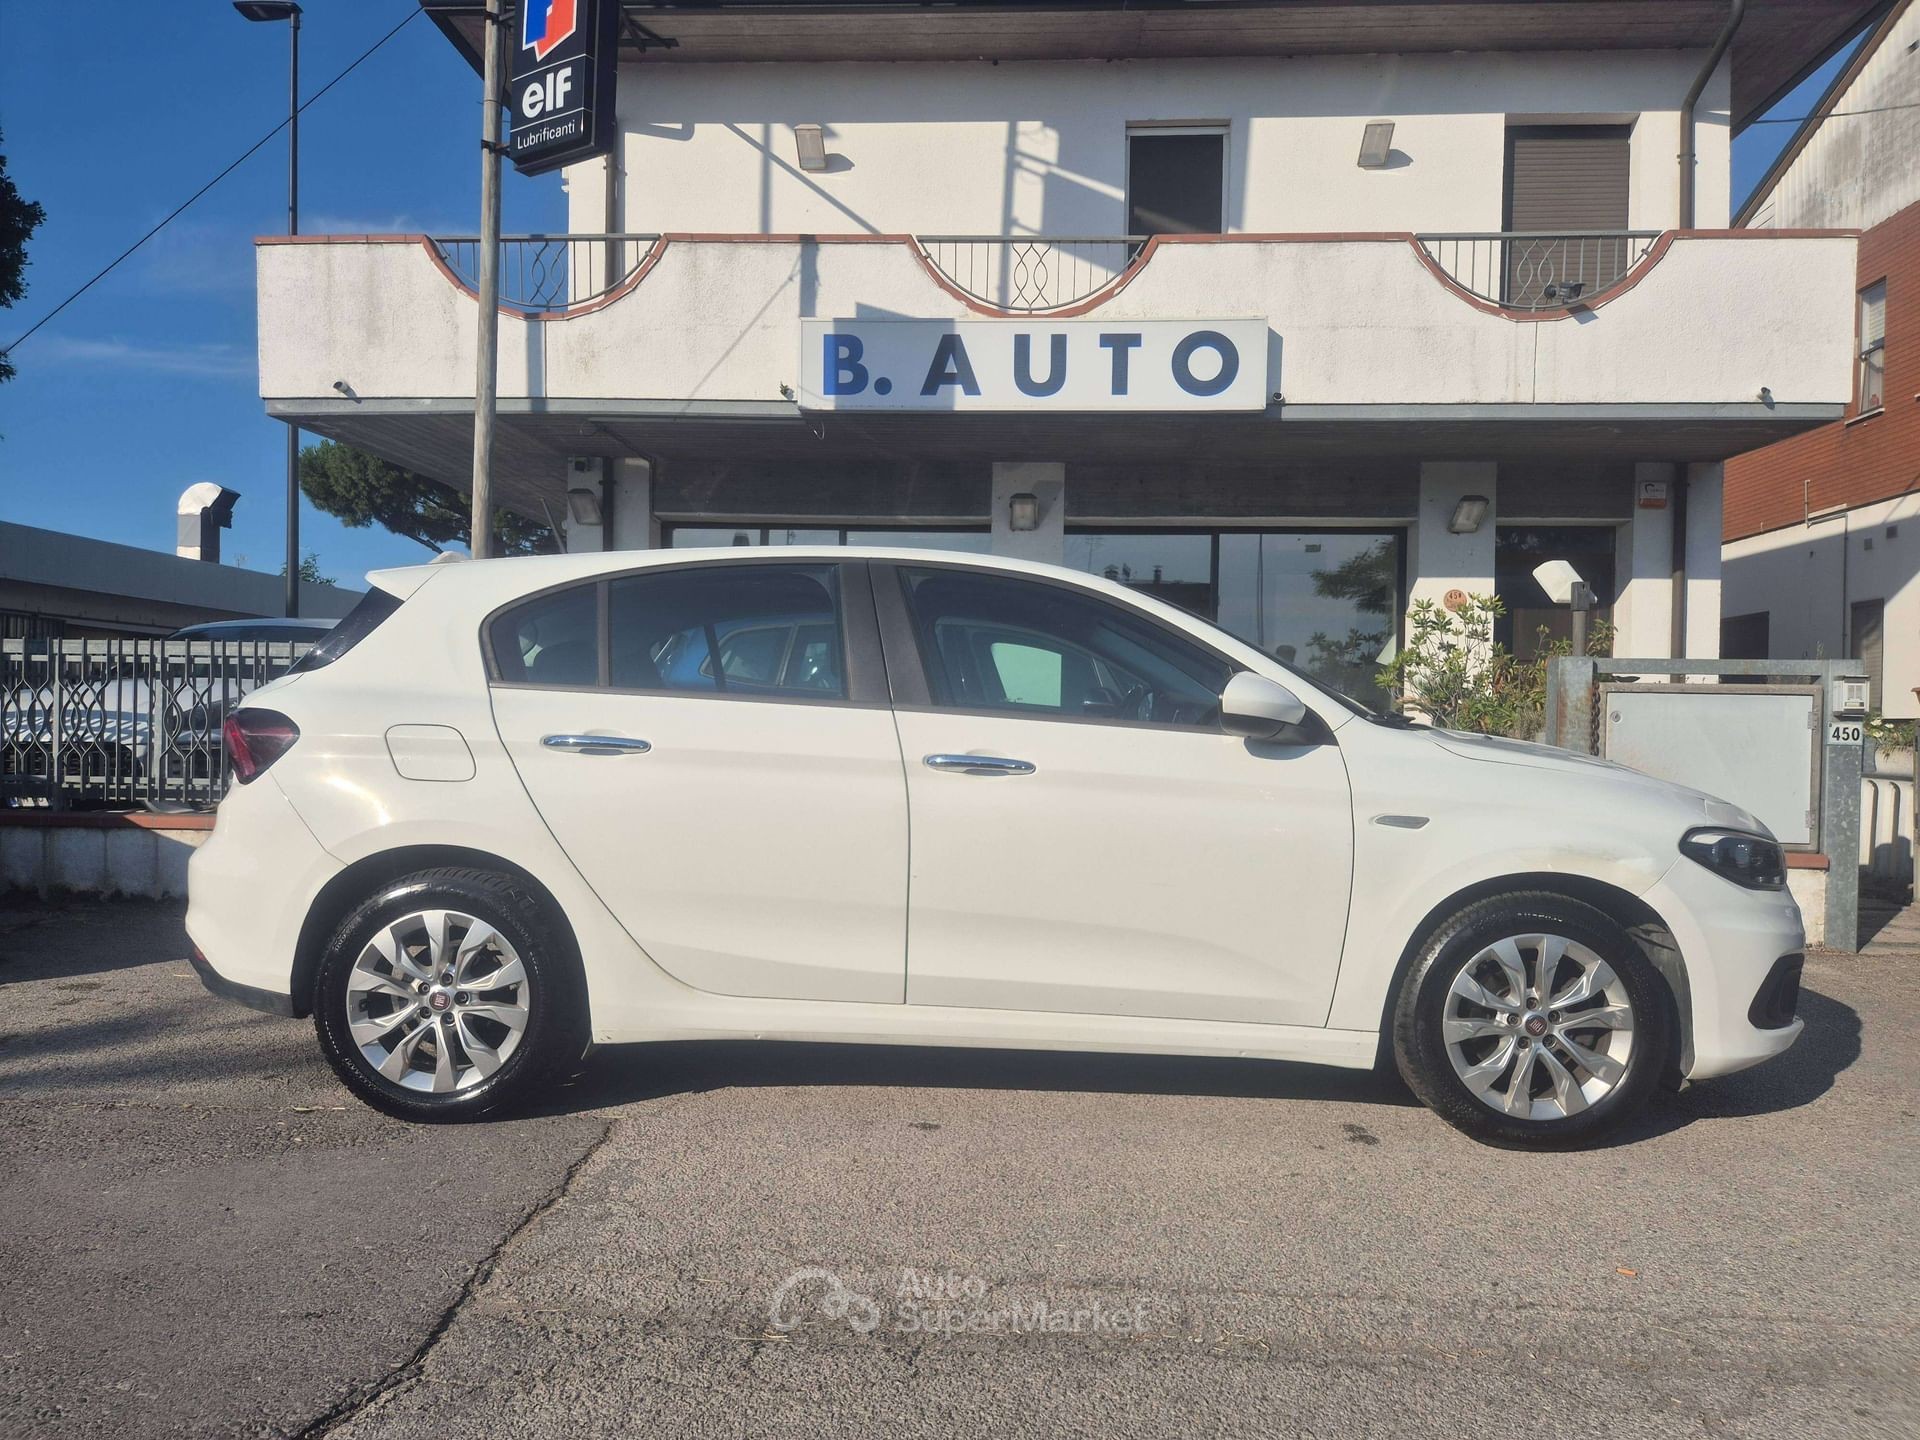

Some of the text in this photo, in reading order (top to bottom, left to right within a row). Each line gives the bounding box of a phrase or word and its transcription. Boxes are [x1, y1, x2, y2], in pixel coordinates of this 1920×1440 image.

[522, 66, 572, 118] elf
[517, 120, 575, 150] Lubrificanti
[823, 330, 1240, 397] B. AUTO
[1832, 726, 1860, 742] 450
